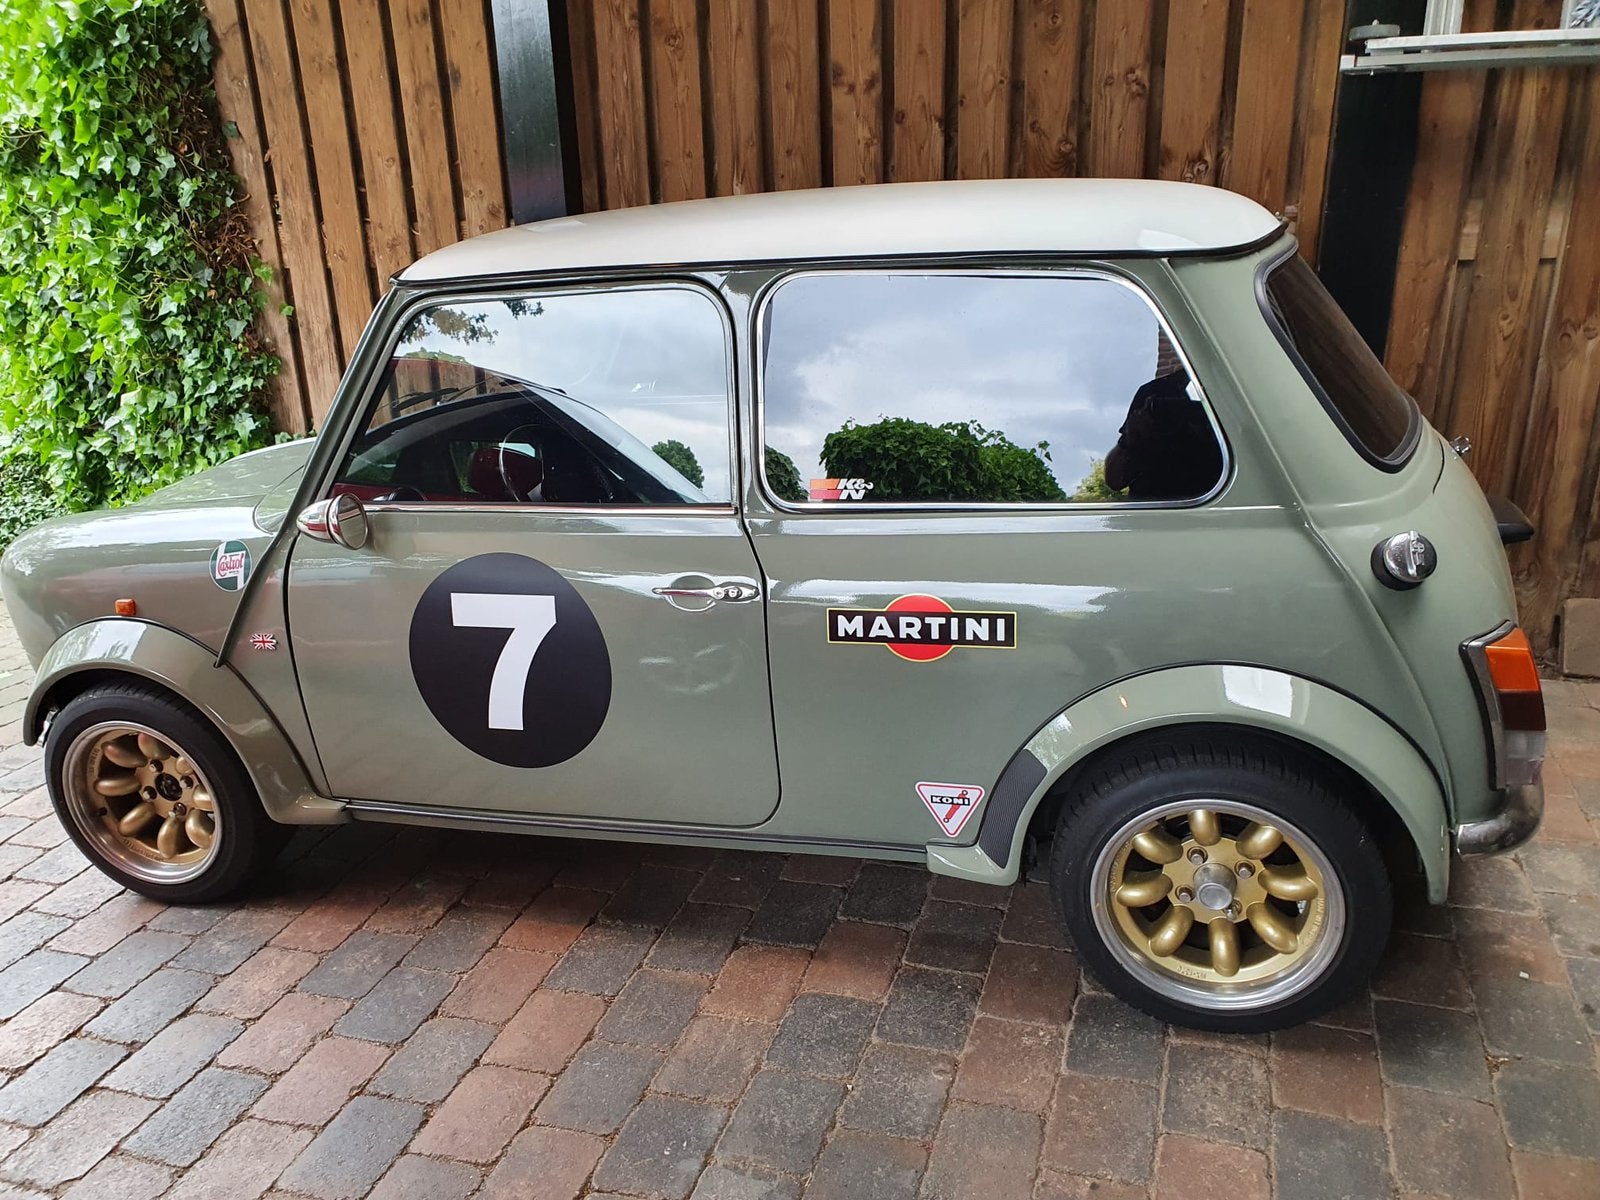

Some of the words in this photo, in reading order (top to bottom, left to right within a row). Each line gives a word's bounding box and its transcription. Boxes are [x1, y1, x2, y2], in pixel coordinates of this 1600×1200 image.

[217, 553, 245, 577] Castrol
[837, 614, 1006, 642] MARTINI
[450, 592, 557, 731] 7
[931, 796, 970, 806] KONI
